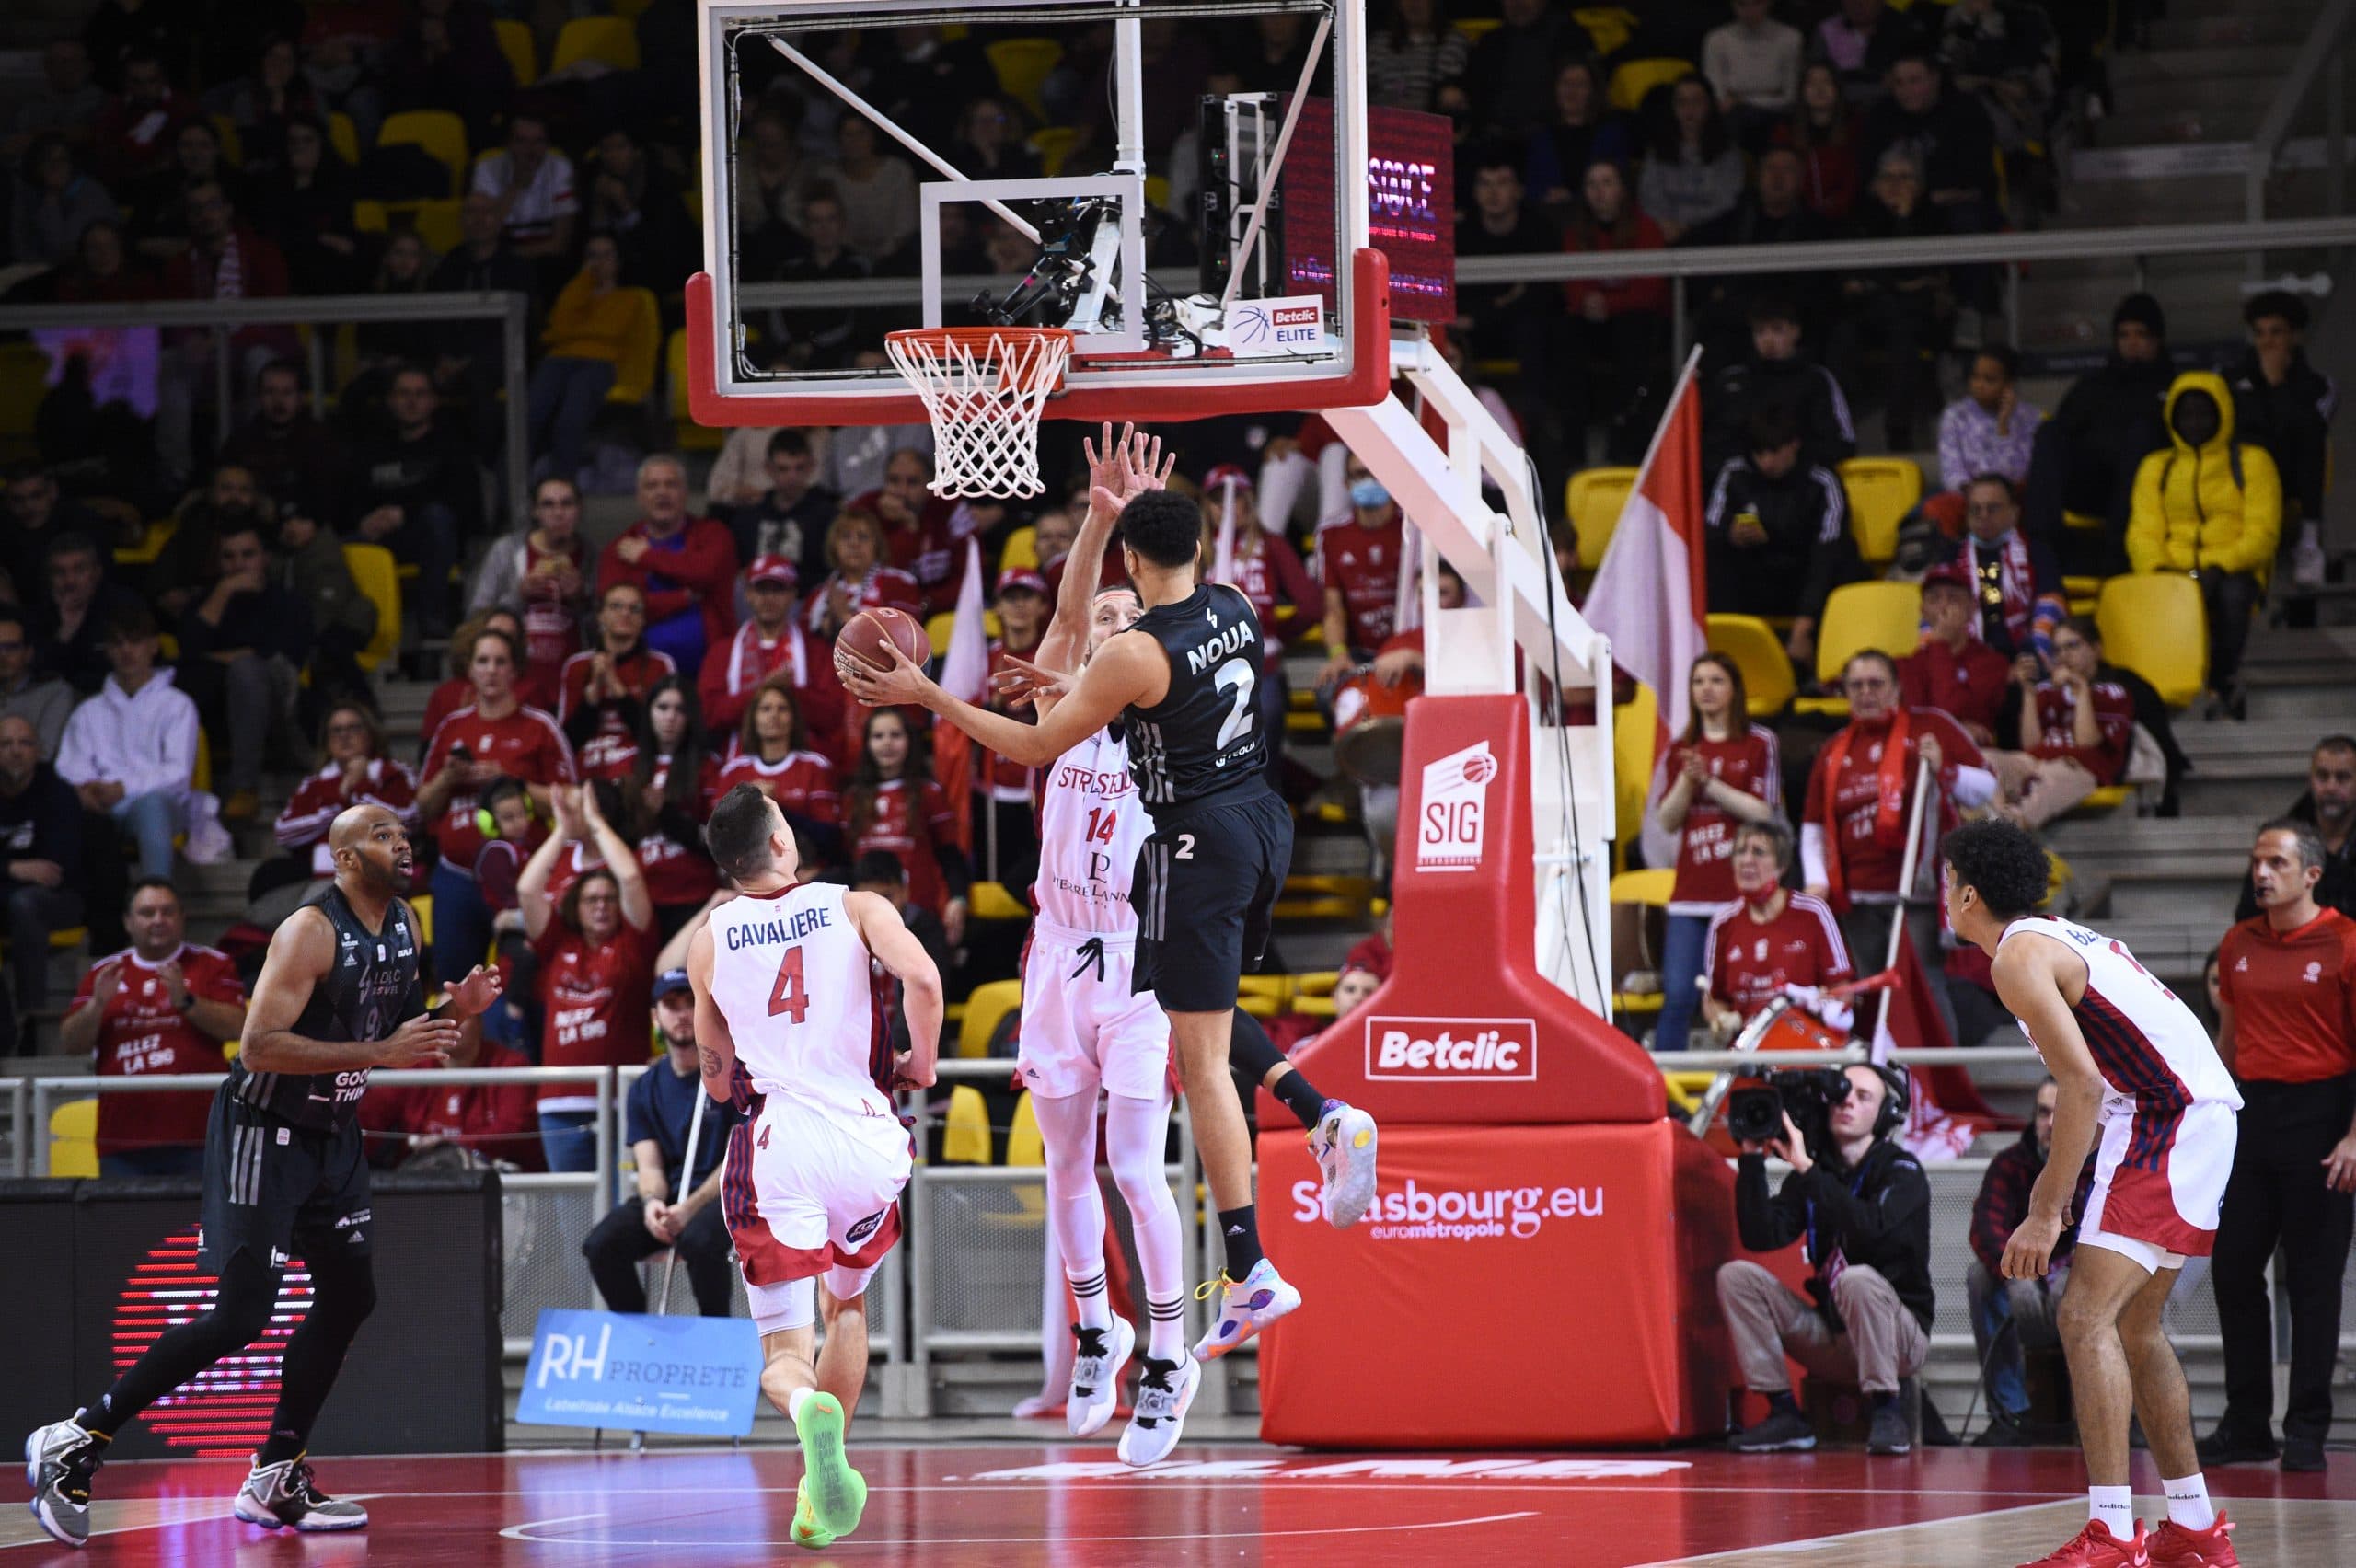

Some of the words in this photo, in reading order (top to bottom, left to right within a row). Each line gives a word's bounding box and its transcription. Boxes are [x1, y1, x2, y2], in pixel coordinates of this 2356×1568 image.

[1276, 309, 1315, 324] Betclic
[1276, 328, 1316, 342] ÉLITE
[1187, 620, 1255, 675] NOUA
[1214, 657, 1255, 751] 2
[1085, 807, 1117, 846] 14
[1425, 801, 1478, 844] SIG
[1174, 834, 1195, 859] 2
[726, 907, 832, 951] CAVALIERE
[768, 945, 810, 1025] 4
[116, 1033, 162, 1061] ALLEZ
[123, 1055, 145, 1075] LA
[1378, 1030, 1521, 1071] Betclic
[335, 1067, 374, 1087] GOO
[757, 1124, 771, 1150] 4
[1291, 1179, 1603, 1238] Stasbourg.eu
[1371, 1220, 1505, 1241] eurométropole
[537, 1323, 612, 1389] RH
[608, 1360, 749, 1388] PROPRETÉ
